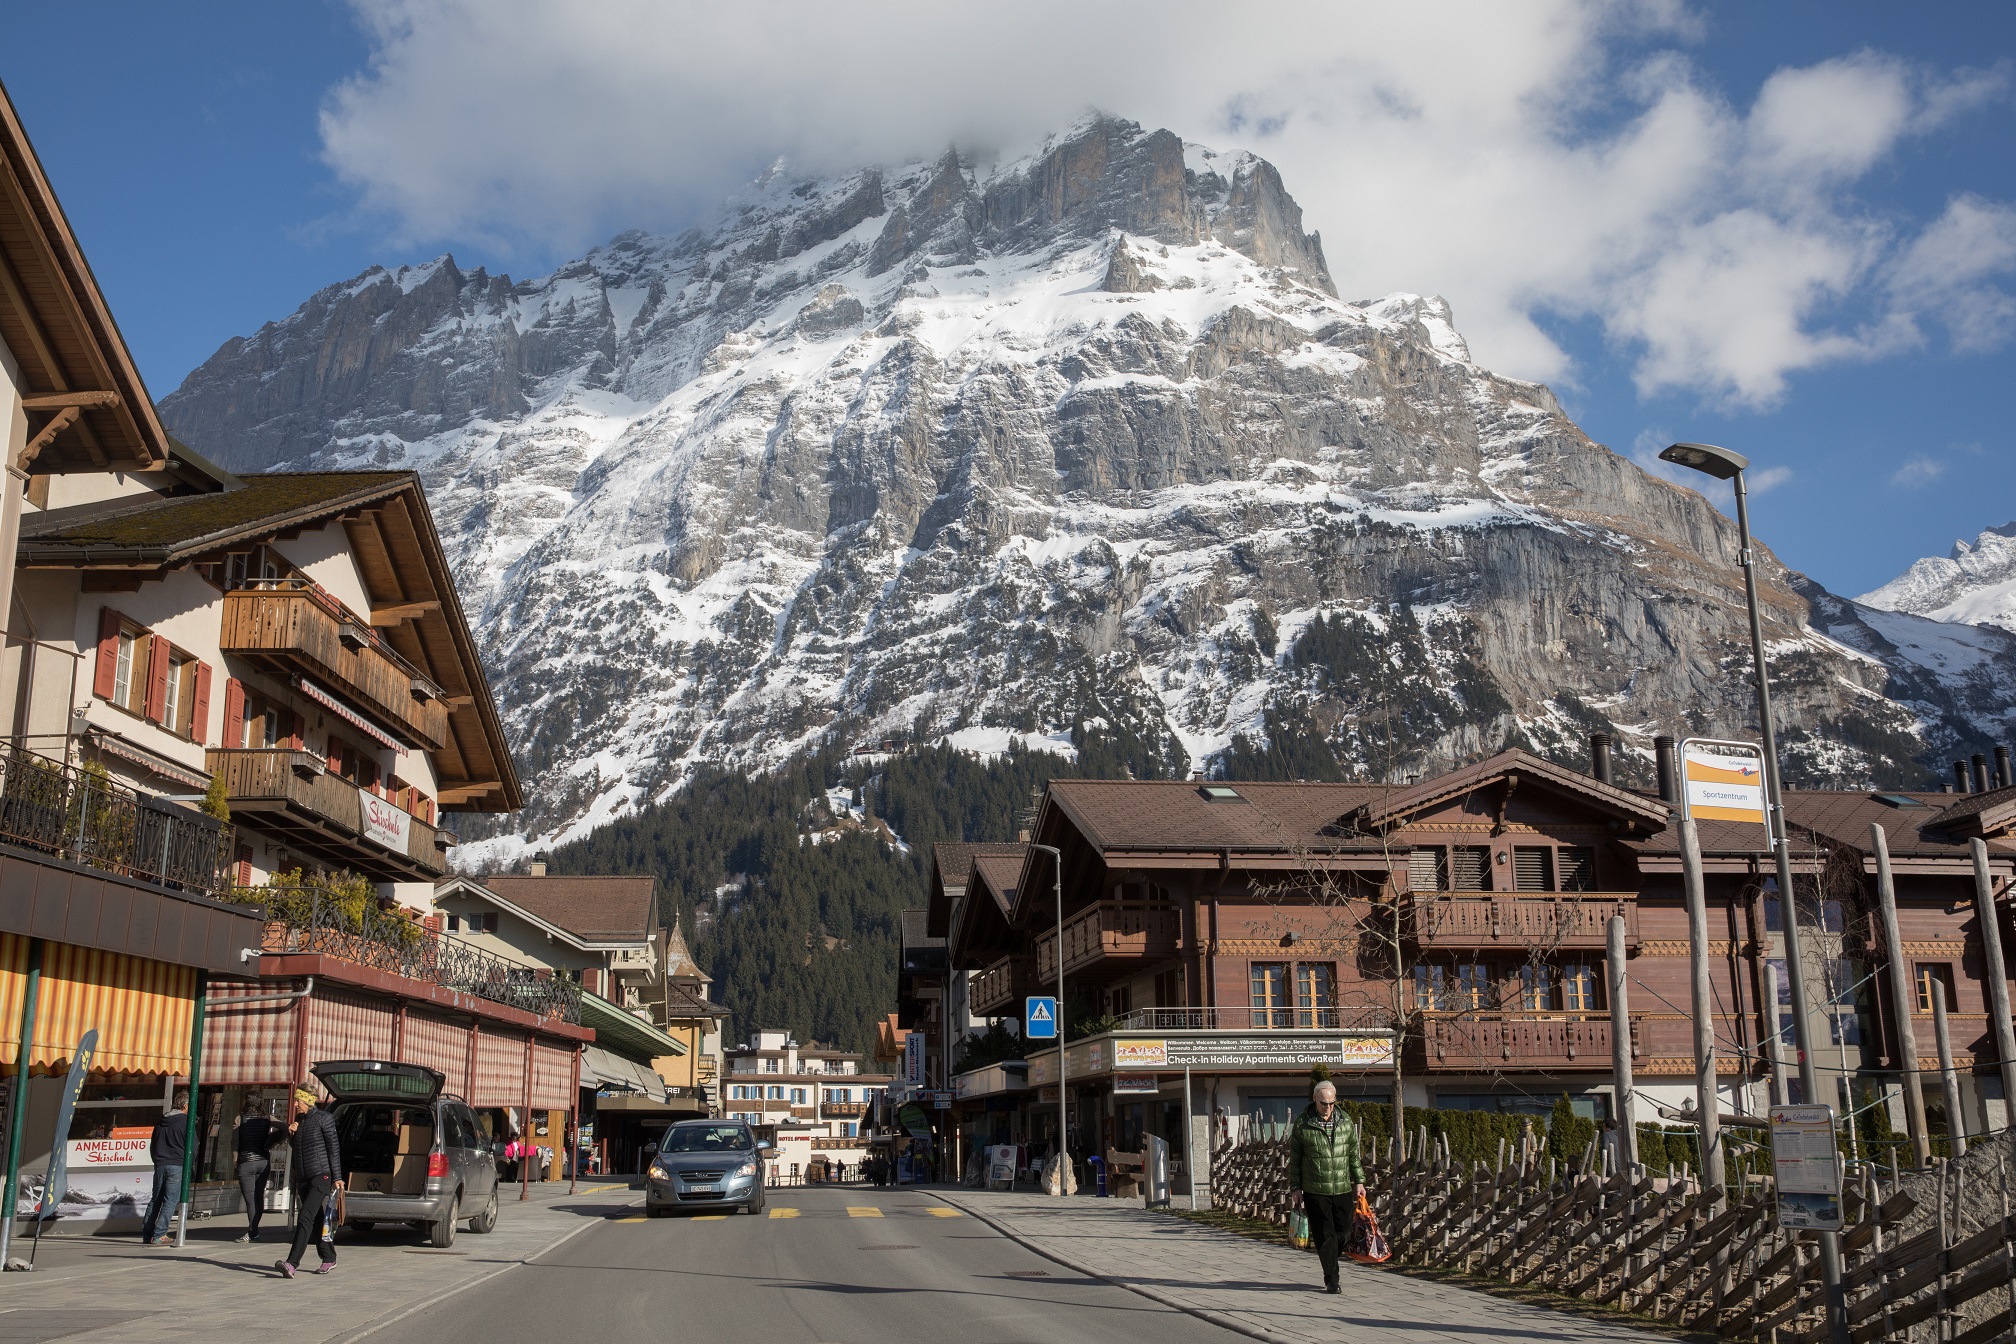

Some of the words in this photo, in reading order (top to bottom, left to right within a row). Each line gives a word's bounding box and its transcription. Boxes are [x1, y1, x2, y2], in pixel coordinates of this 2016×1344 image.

[1702, 790, 1748, 801] Sportzentrum
[368, 800, 401, 836] Skischule
[1167, 1055, 1209, 1064] Check-in
[1210, 1055, 1246, 1065] Holiday
[1245, 1054, 1296, 1065] Apartments
[1296, 1054, 1342, 1063] GriwaRent
[1793, 1113, 1820, 1121] Grindelwald
[74, 1140, 147, 1152] ANMELDUNG
[85, 1151, 134, 1163] Skischule
